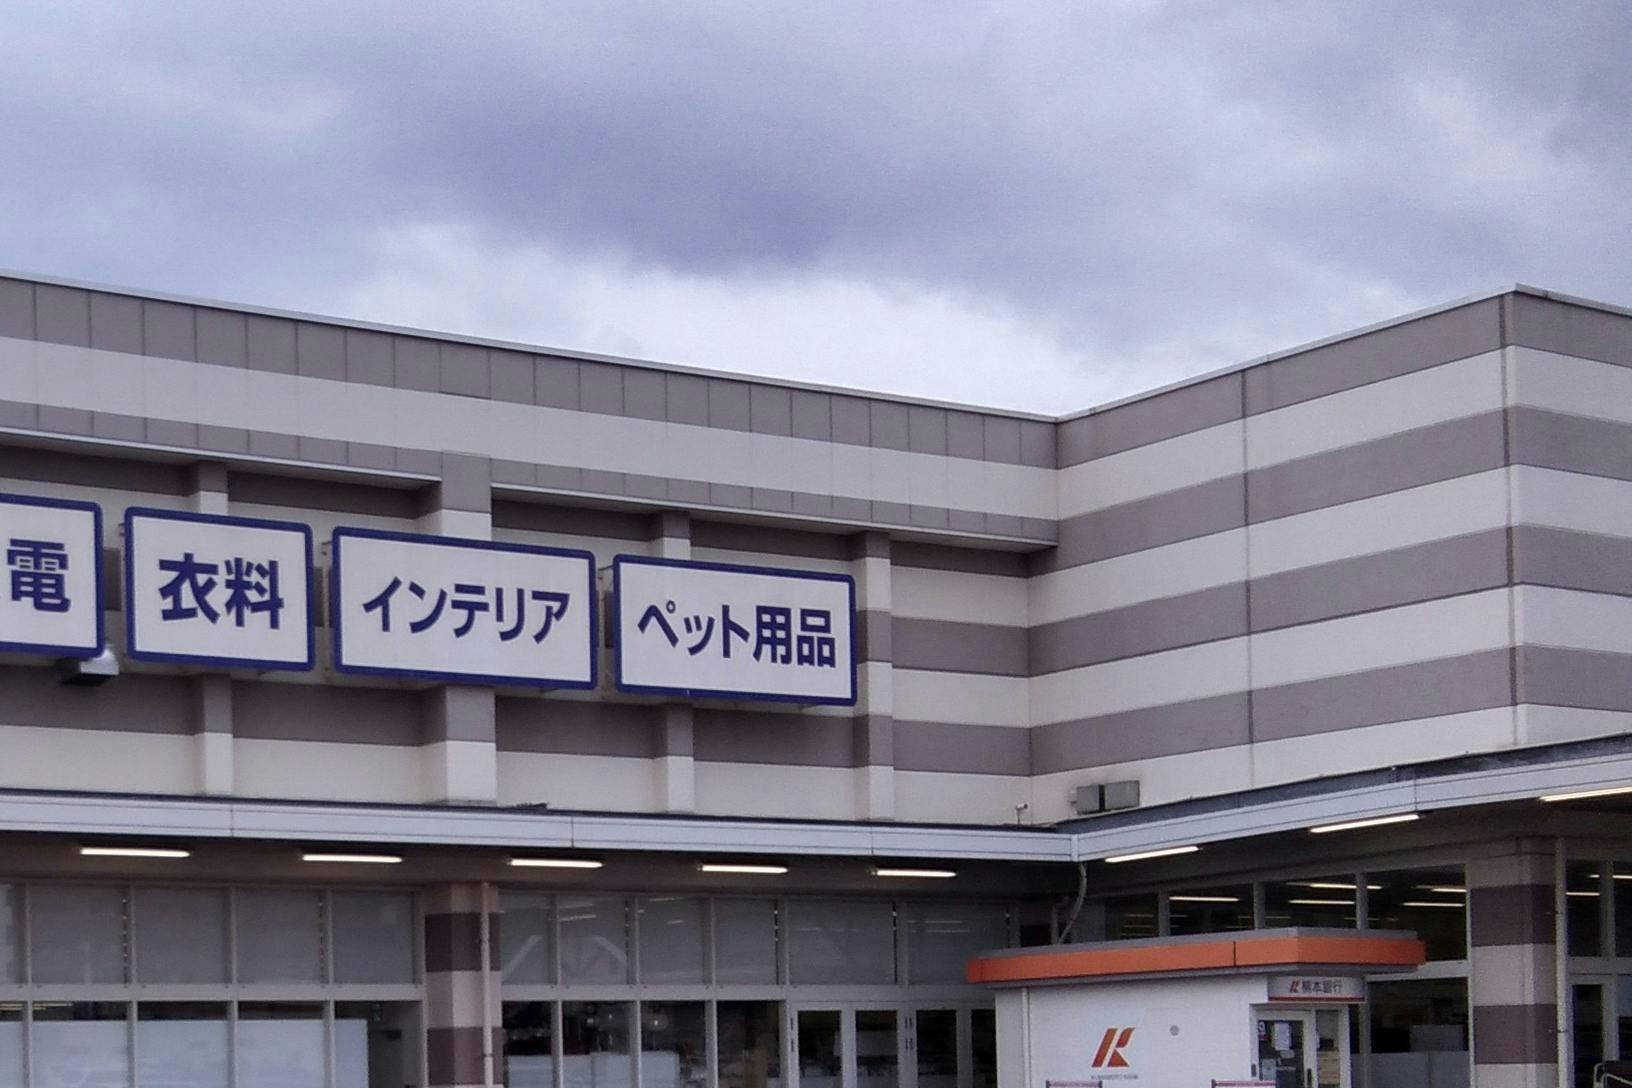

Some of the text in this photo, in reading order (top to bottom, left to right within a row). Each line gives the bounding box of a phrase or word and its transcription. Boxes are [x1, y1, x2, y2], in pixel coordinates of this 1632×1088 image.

[158, 552, 284, 630] 衣料
[362, 576, 570, 644] インテリア
[637, 600, 836, 669] ペット用品
